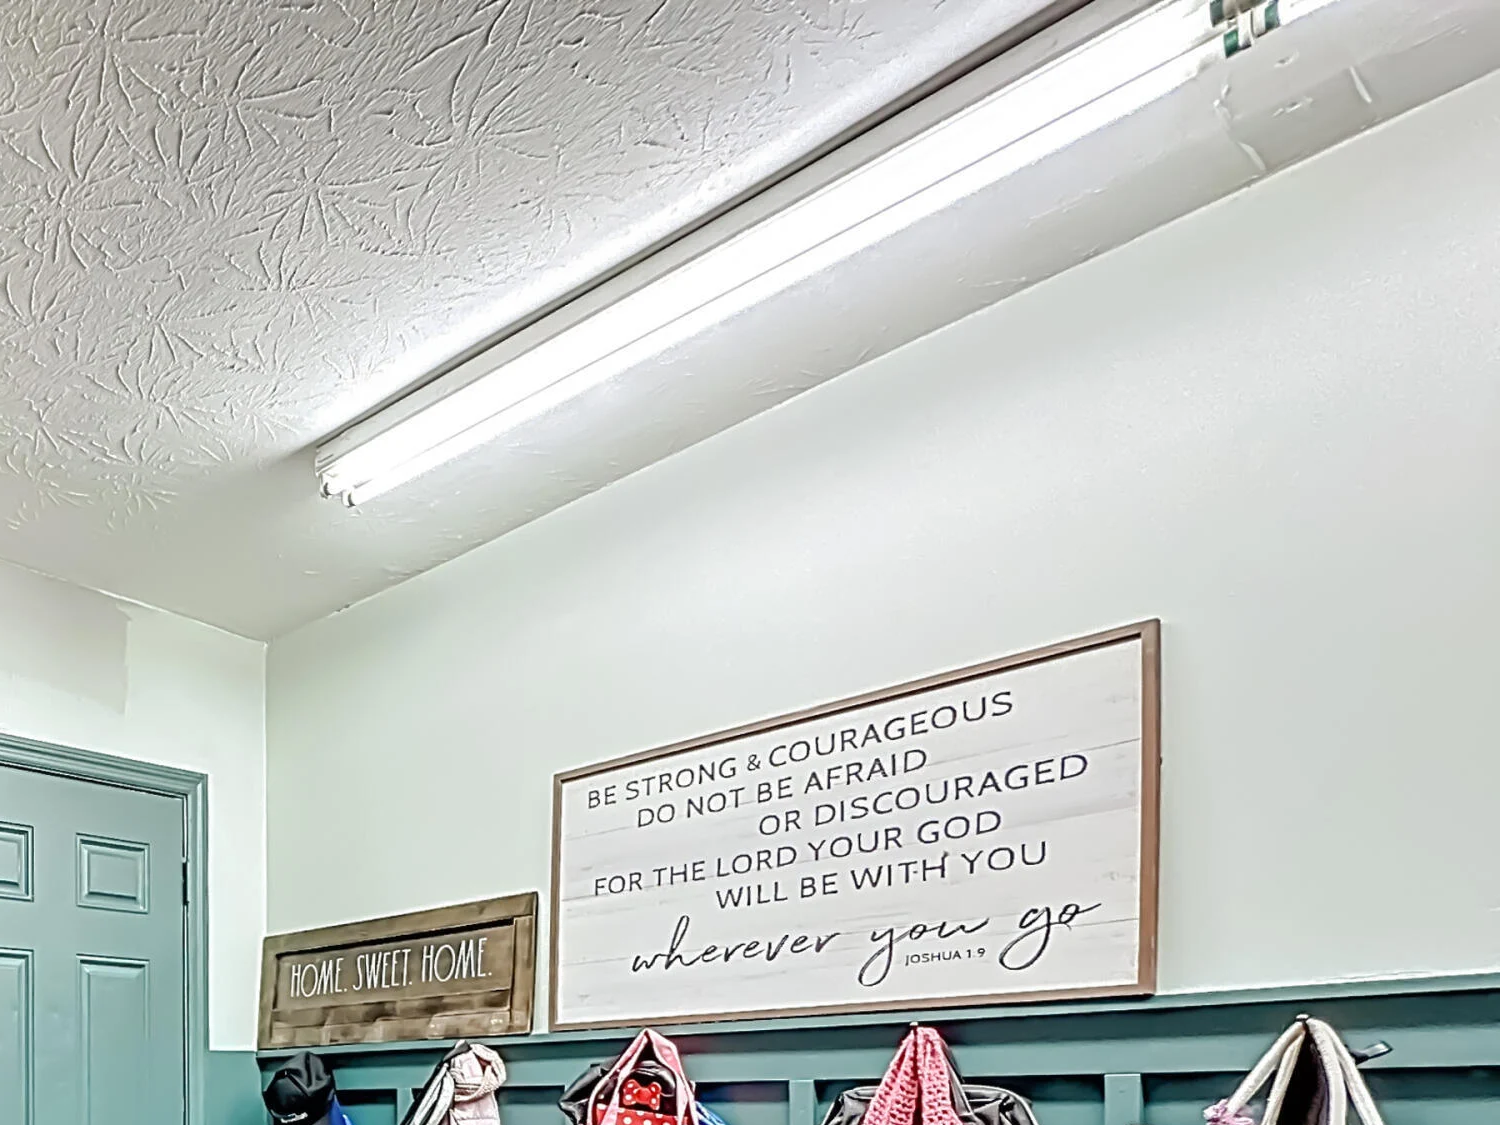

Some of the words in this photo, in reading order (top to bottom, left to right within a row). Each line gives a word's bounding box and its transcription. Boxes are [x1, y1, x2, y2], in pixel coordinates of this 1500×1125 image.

[587, 785, 617, 809] BE
[625, 757, 737, 801] STRONG
[746, 754, 761, 773] &
[768, 691, 1013, 767] COURAGEOUS
[637, 804, 675, 828] DO
[686, 787, 745, 819] NOT
[757, 776, 793, 803] BE
[804, 749, 927, 794] AFRAID
[759, 810, 801, 836] OR
[815, 754, 1088, 826] DISCOURAGED
[594, 872, 643, 896] FOR
[653, 860, 706, 887] THE
[716, 846, 797, 878] LORD
[807, 827, 903, 861] YOUR
[917, 810, 1002, 844] GOD
[716, 881, 788, 909] WILL
[800, 873, 838, 899] BE
[850, 851, 948, 890] WITH
[961, 841, 1046, 875] YOU
[290, 957, 348, 998] HOME.
[352, 949, 412, 991] SWEET.
[421, 937, 492, 983] HOME.
[631, 915, 841, 973] wherever
[857, 917, 990, 987] you
[999, 902, 1102, 971] go
[904, 950, 962, 967] JOSHUA
